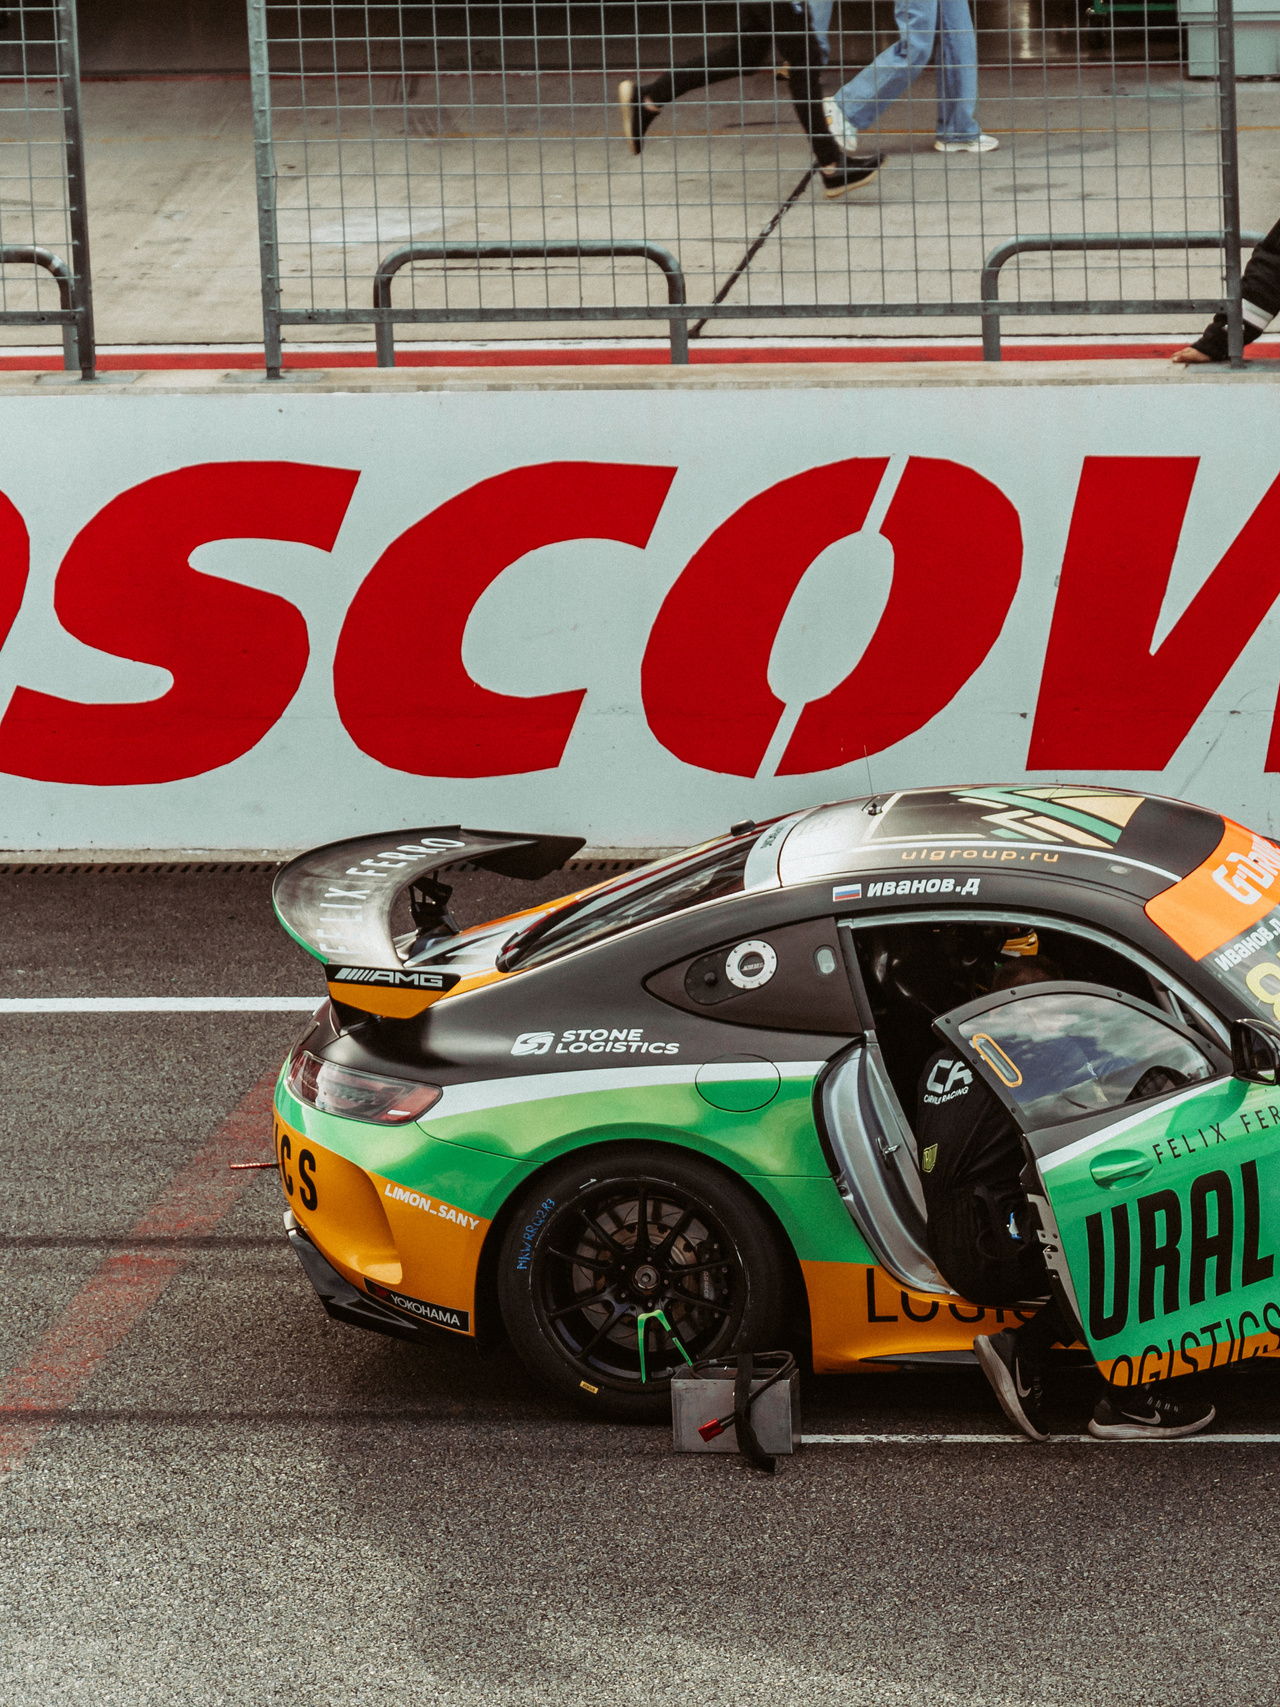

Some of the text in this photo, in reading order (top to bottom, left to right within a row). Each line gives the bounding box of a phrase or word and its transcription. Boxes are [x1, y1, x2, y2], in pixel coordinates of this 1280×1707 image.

[901, 848, 1059, 863] ulgroup.ru
[315, 837, 466, 955] FELIX FERRO
[369, 970, 443, 988] AMG
[555, 1041, 680, 1054] LOGISTICS
[561, 1029, 644, 1042] STONE
[1152, 1122, 1227, 1164] FELIX
[384, 1183, 480, 1231] LIMON_SANY
[1084, 1159, 1275, 1341] URAL
[390, 1293, 461, 1327] YOKOHAMA
